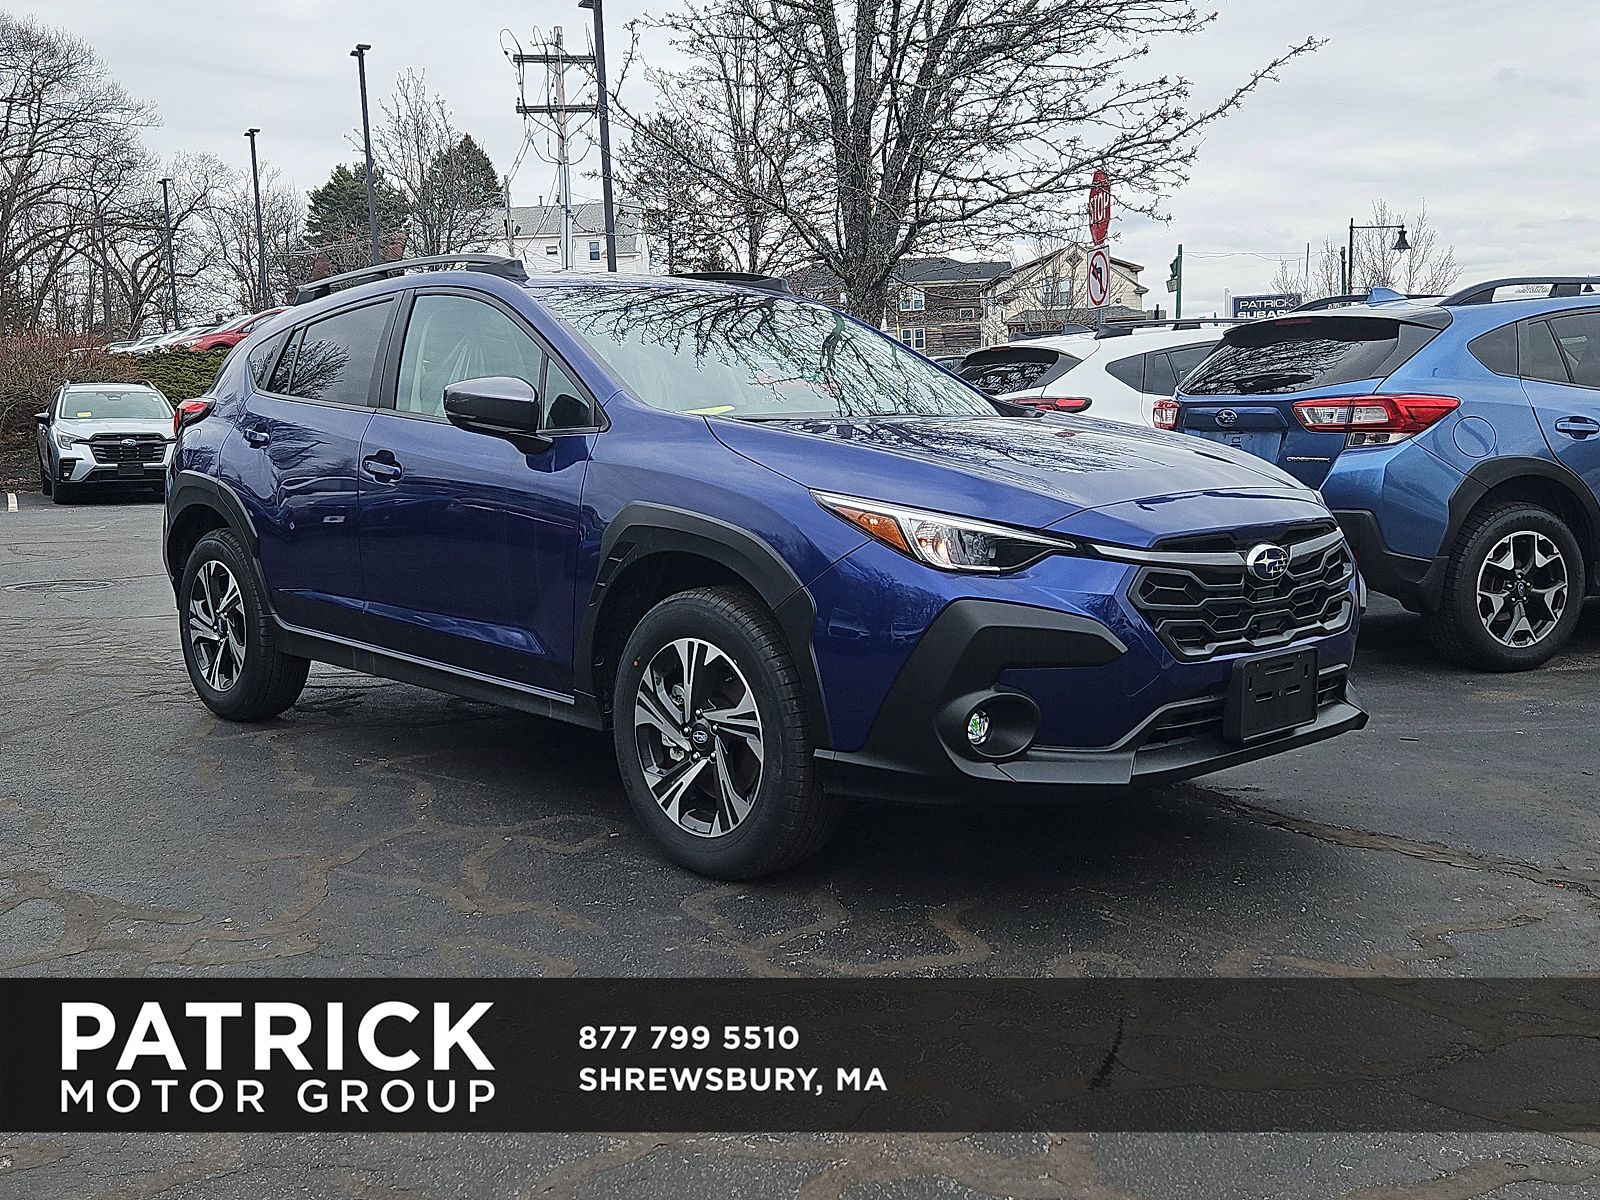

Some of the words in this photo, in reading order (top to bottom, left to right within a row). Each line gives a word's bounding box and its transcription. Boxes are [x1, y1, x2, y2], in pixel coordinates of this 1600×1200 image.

[1089, 191, 1110, 224] STOP
[1239, 298, 1295, 309] PATRICK
[1236, 309, 1291, 319] SUBAR
